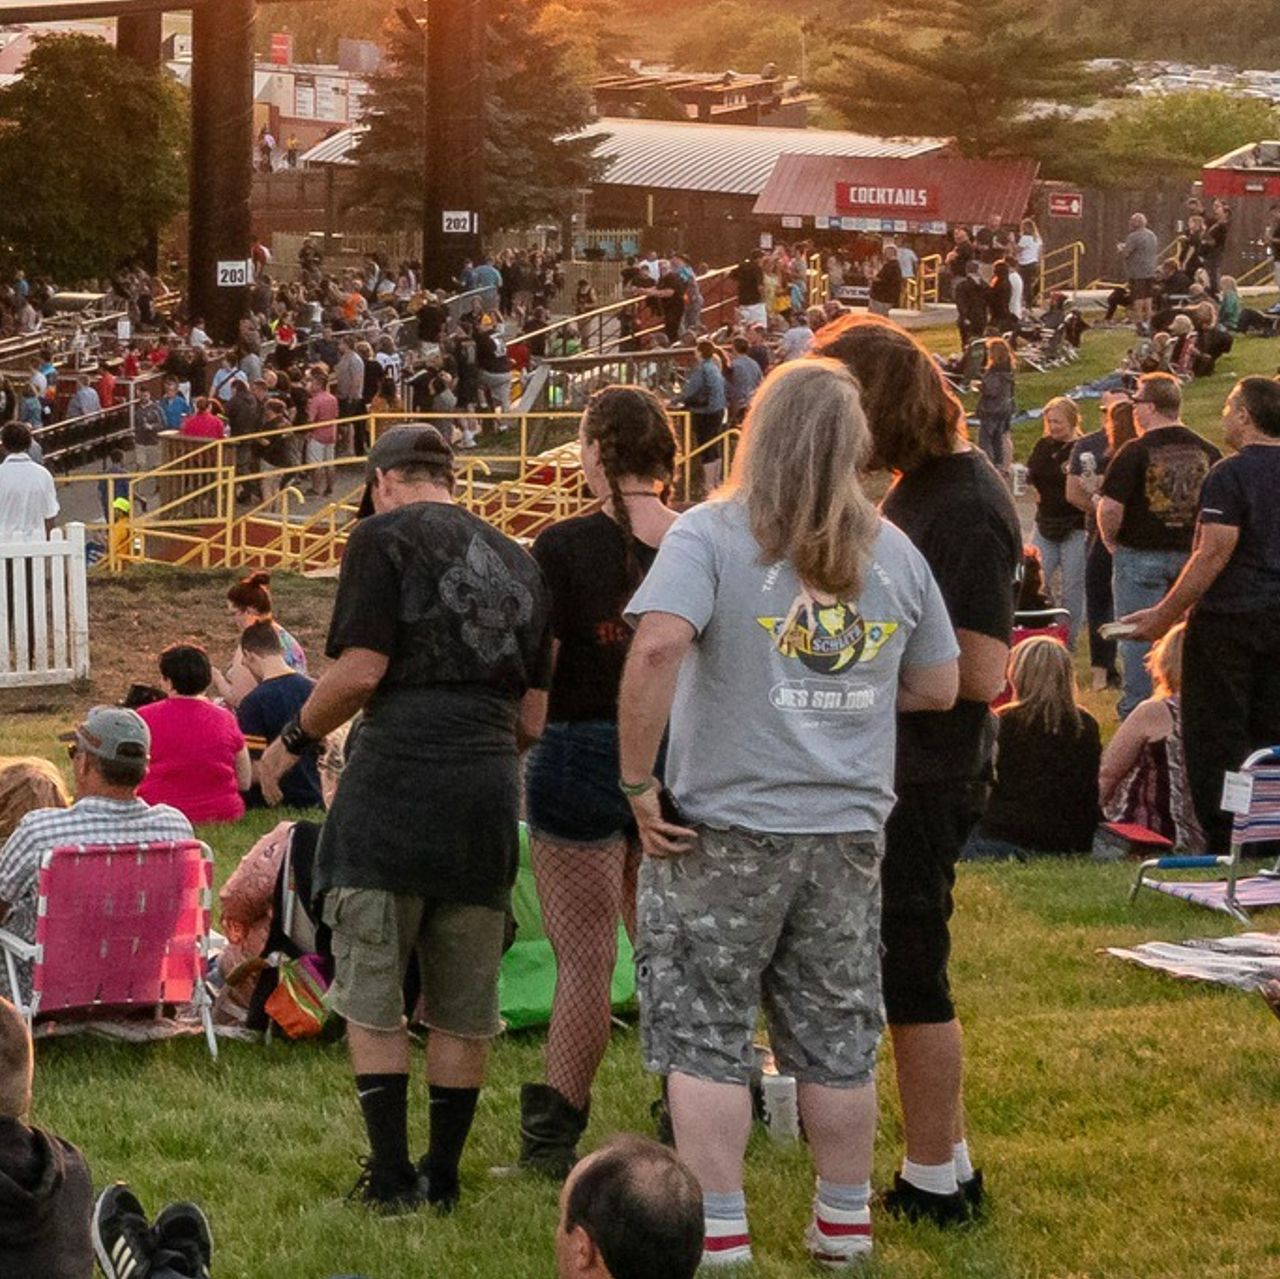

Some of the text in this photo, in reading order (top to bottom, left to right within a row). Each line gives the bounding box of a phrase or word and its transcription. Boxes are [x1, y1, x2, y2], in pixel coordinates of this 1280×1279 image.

[849, 186, 928, 207] COCKTAILS
[445, 217, 468, 231] 202
[220, 268, 245, 284] 203
